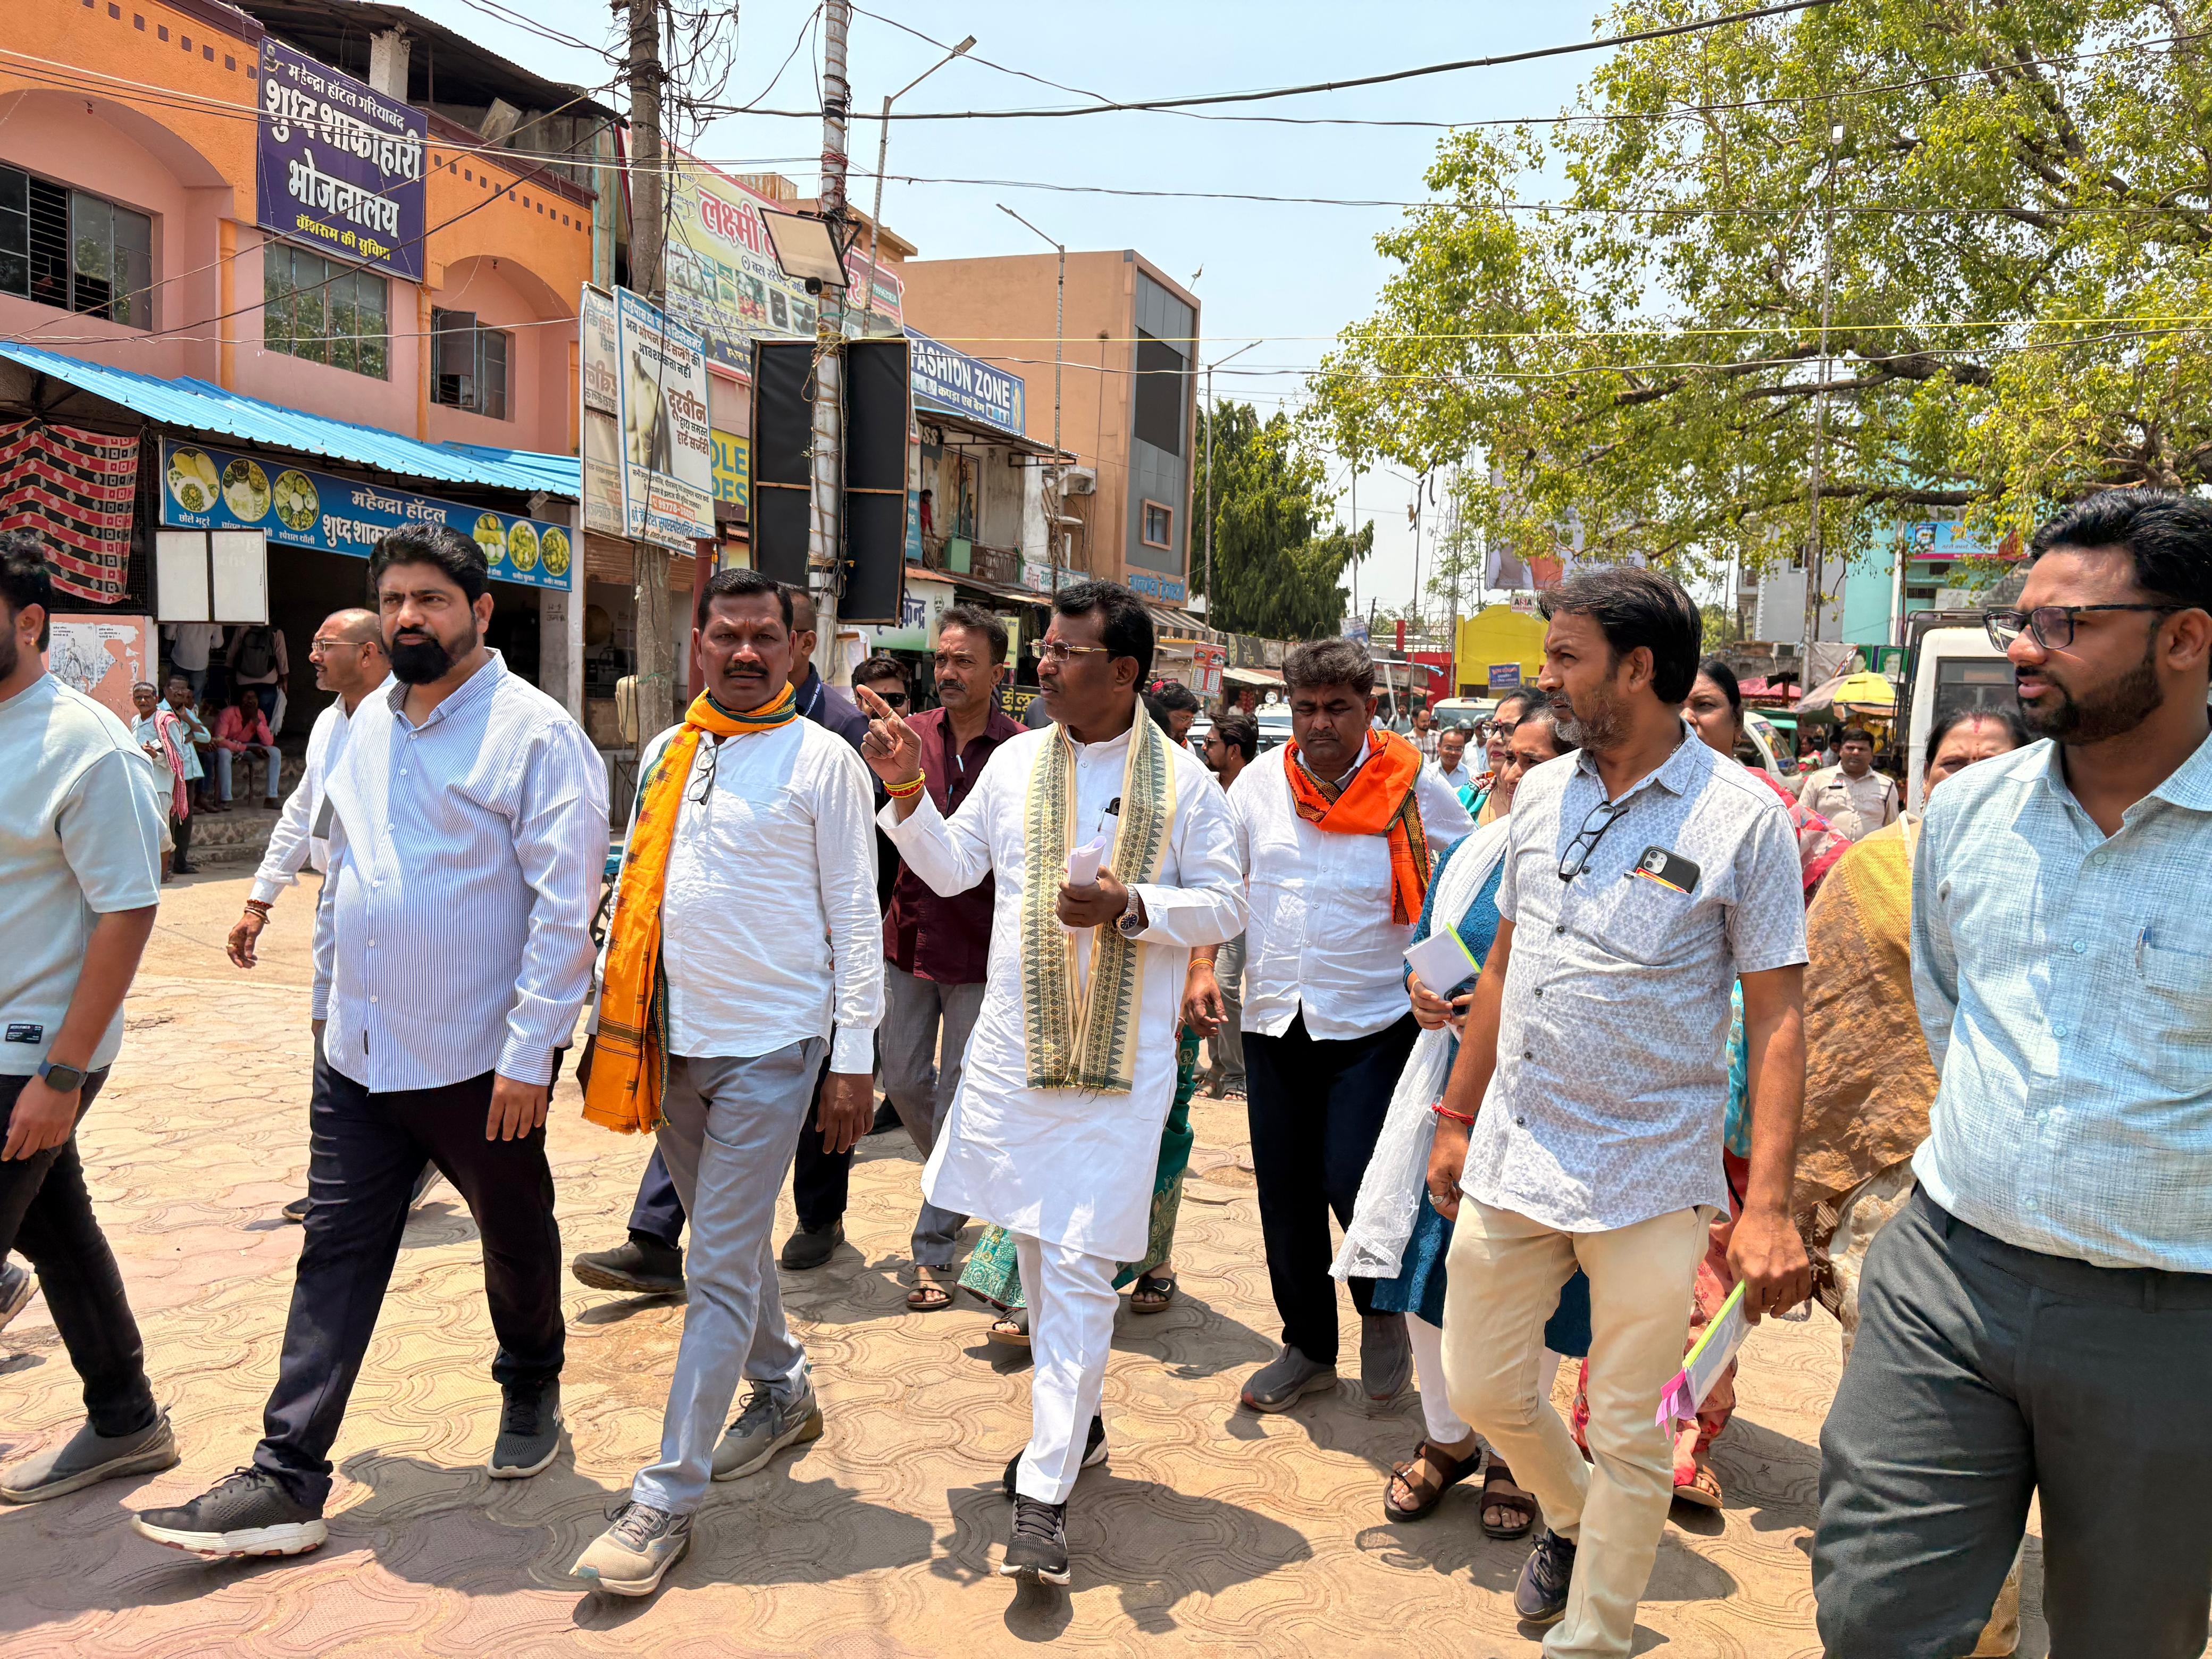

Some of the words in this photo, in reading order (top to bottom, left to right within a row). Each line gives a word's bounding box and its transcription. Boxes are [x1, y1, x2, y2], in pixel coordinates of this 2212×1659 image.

[328, 79, 356, 107] हॉटल
[359, 96, 404, 131] गरियाबंद
[320, 103, 421, 182] शाकाहारी
[697, 189, 760, 254] लक्ष्मी
[341, 230, 356, 248] की
[358, 238, 391, 261] सुविधा
[691, 353, 700, 368] की
[911, 339, 972, 392] FASHION
[975, 368, 1010, 409] ZONE
[667, 387, 707, 424] दूरबीन
[351, 488, 403, 515] महेन्द्रा
[406, 499, 447, 524] हॉटल
